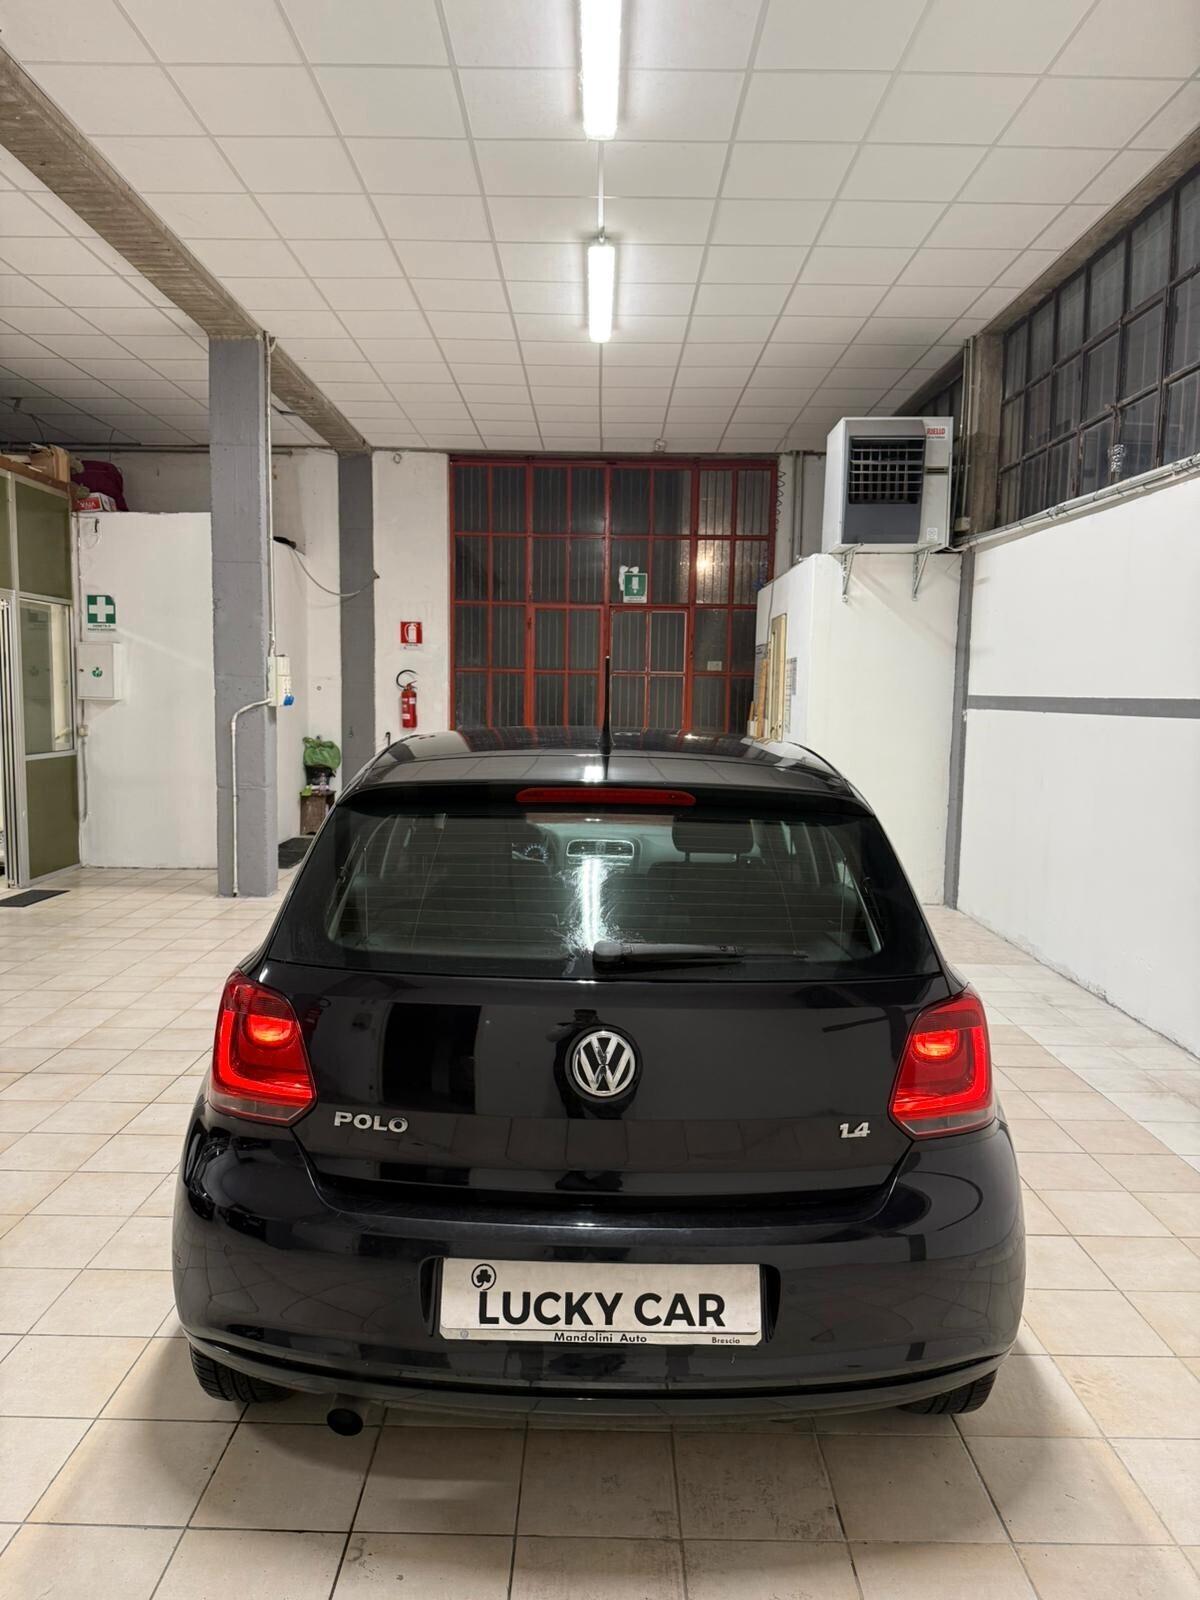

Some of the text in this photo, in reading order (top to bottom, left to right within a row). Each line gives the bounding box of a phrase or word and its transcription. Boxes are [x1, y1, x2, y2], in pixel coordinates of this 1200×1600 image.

[334, 1111, 409, 1133] POLO
[479, 1291, 726, 1327] LUCKY CAR
[554, 1332, 741, 1344] Mandolini Auto Brescia
